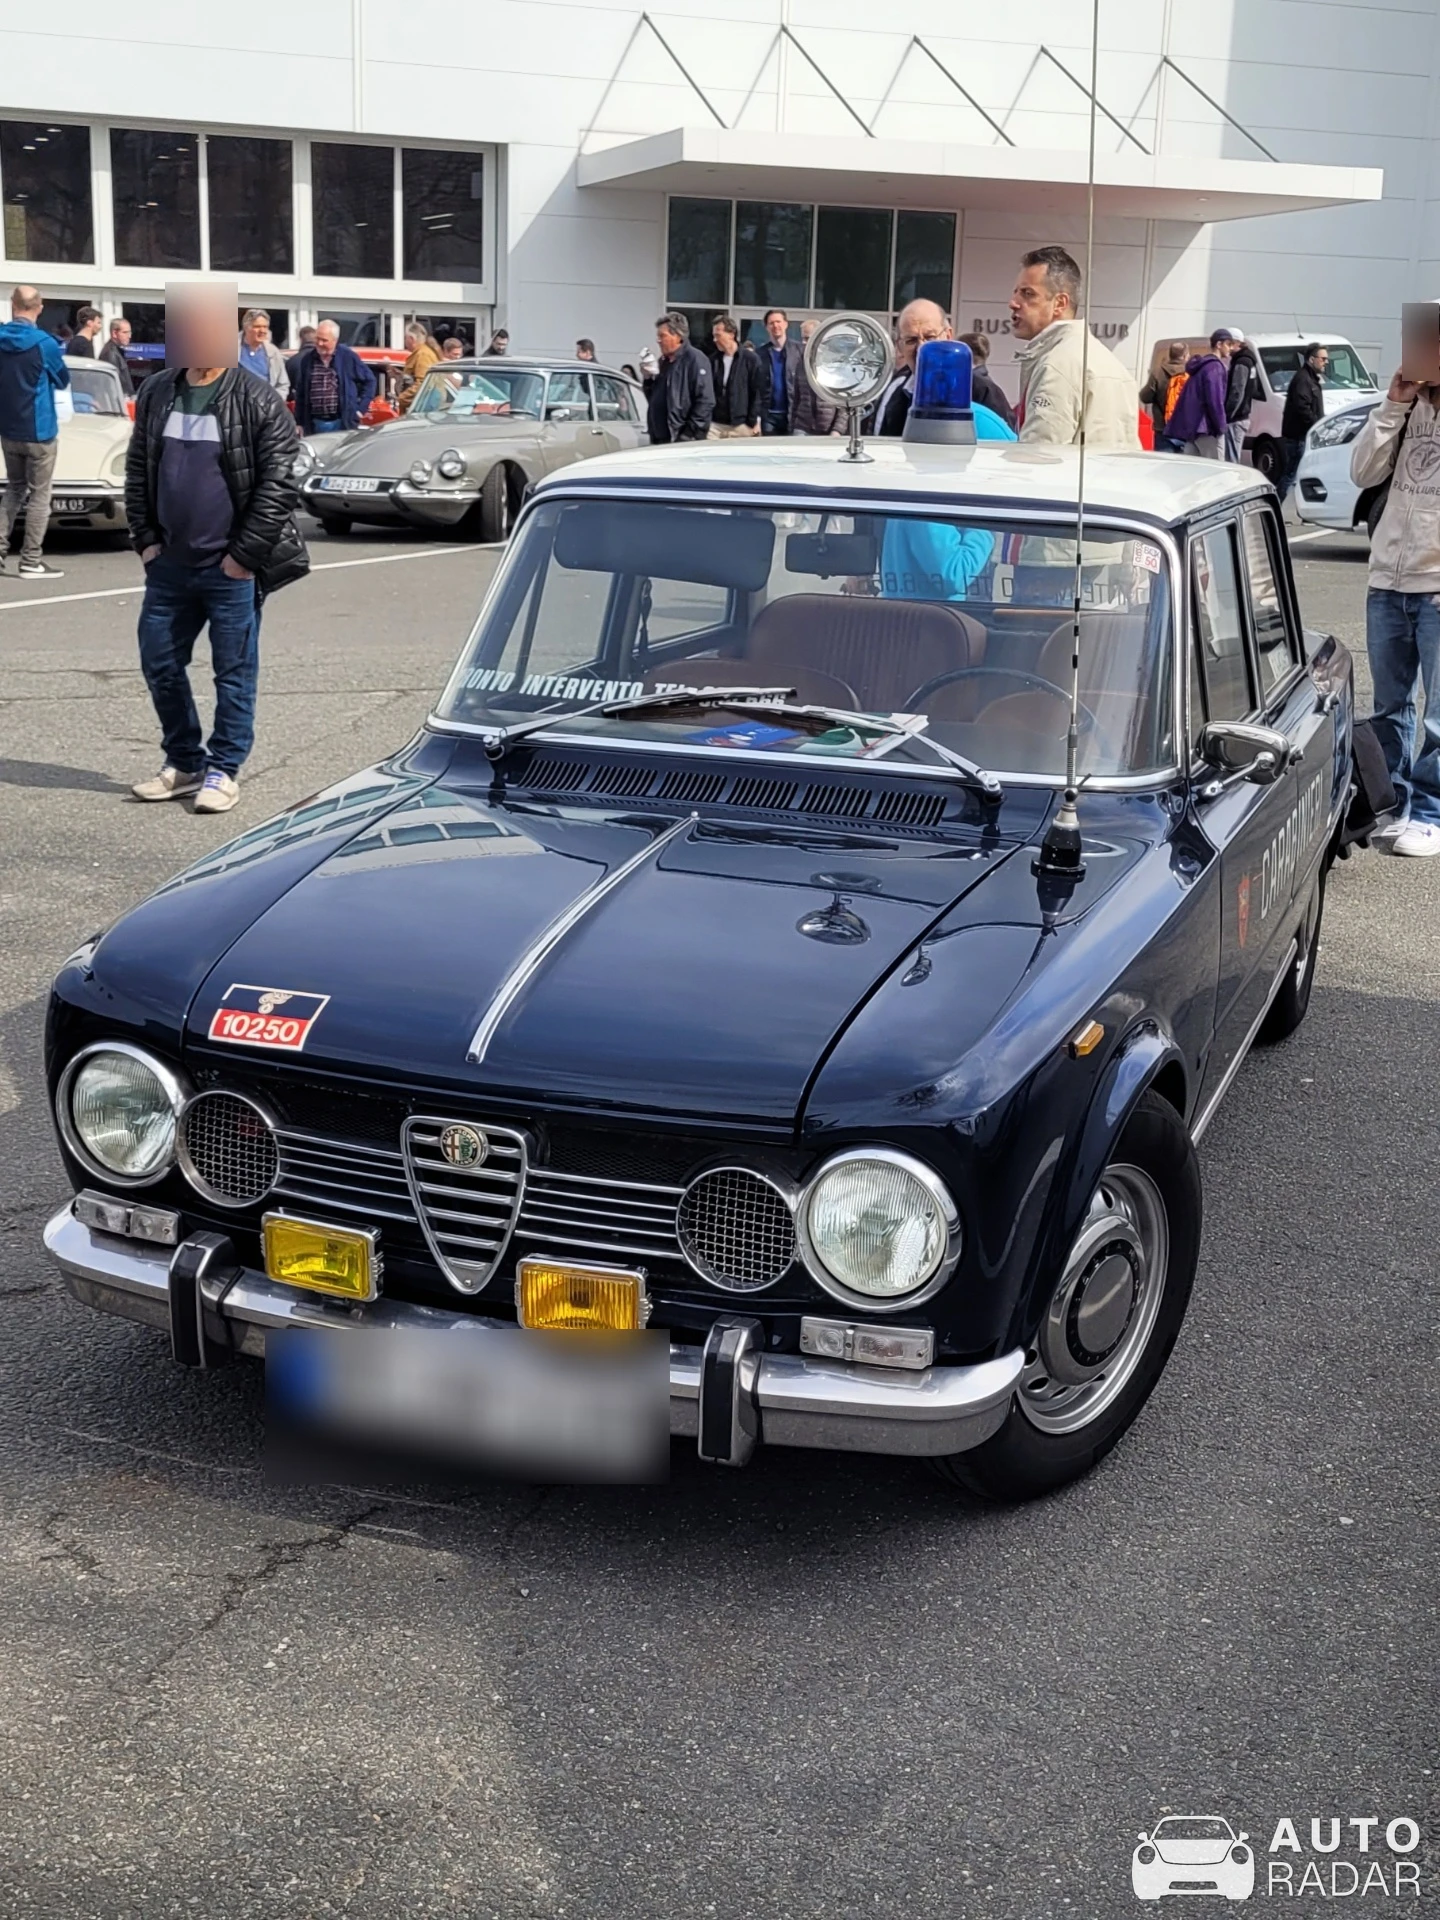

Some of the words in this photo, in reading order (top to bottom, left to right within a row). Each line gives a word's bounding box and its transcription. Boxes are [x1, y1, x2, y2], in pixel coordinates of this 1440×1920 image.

[1089, 322, 1130, 338] LUB
[1415, 485, 1440, 497] LAURE
[519, 673, 644, 702] INTERVENTO
[223, 1013, 300, 1043] 10250
